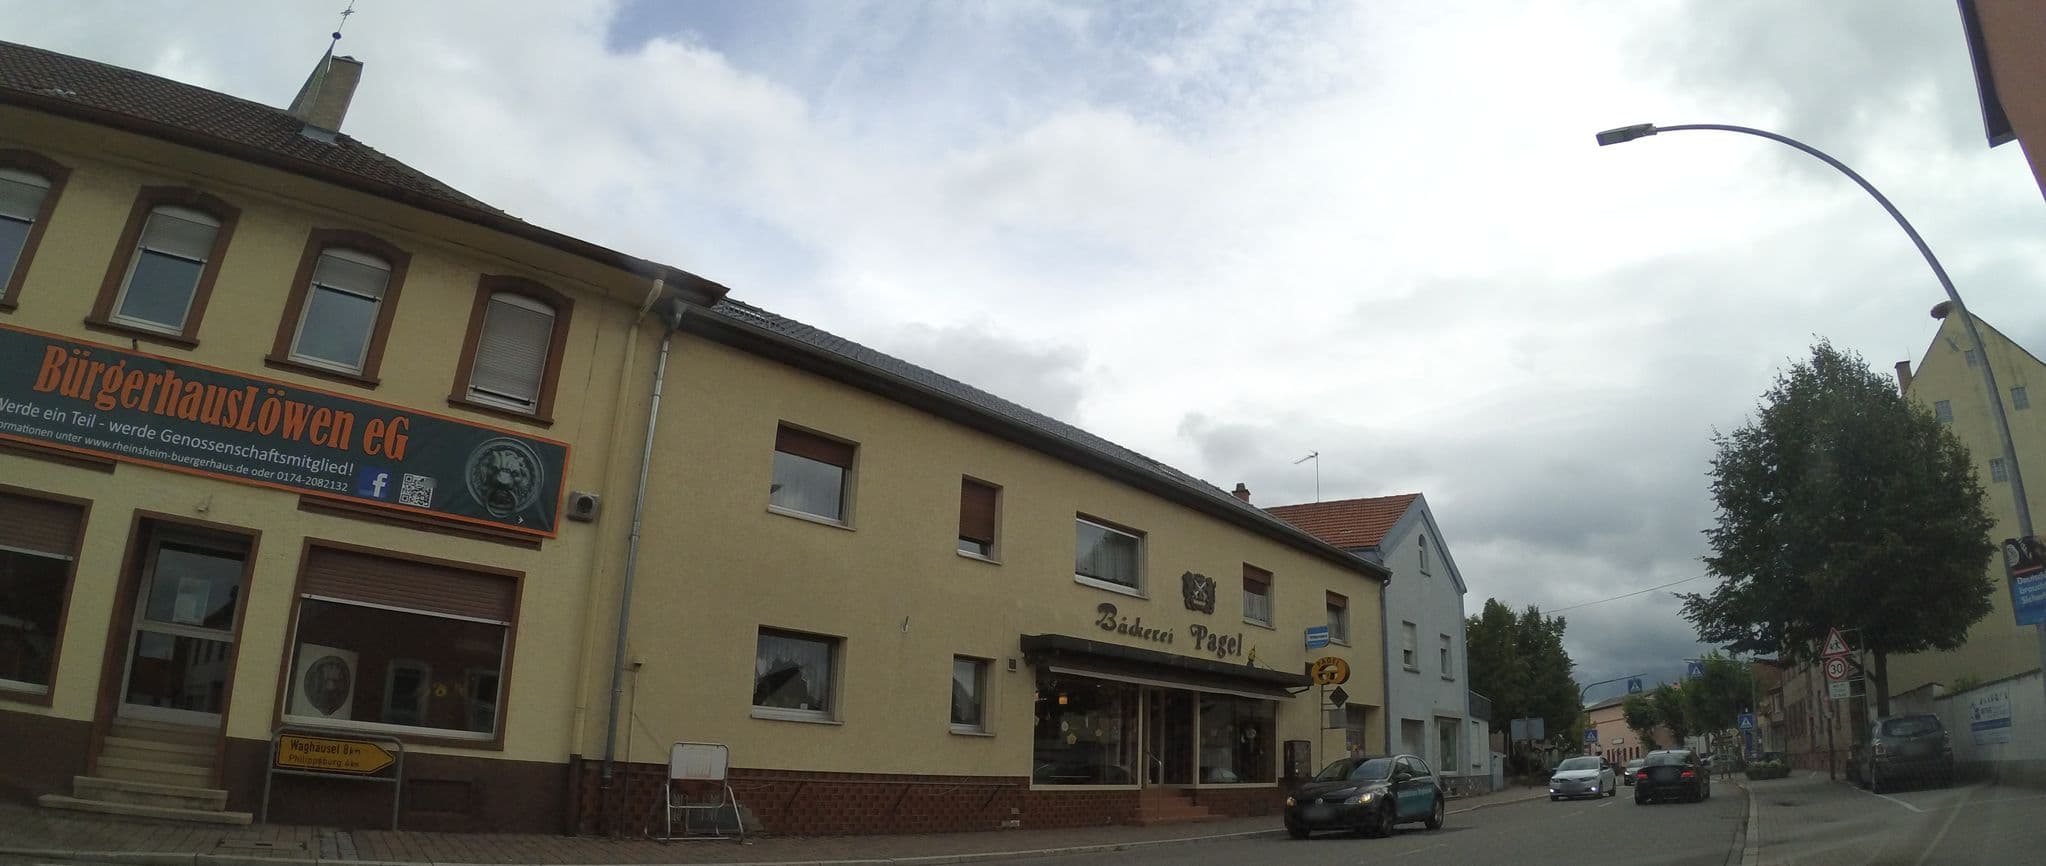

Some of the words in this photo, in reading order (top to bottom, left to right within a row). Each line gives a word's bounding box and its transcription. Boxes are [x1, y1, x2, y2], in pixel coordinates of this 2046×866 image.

[33, 344, 355, 450] BürgerhausLöwen
[363, 416, 409, 461] eG
[0, 421, 53, 439] ormationen
[56, 431, 82, 444] unter
[84, 437, 249, 475] www.rheinsheim-buergerhaus.de
[251, 468, 276, 480] oder
[277, 471, 349, 492] 0174-2082132
[43, 407, 66, 423] ein
[72, 410, 97, 428] Teil
[109, 420, 156, 440] werde
[160, 429, 354, 476] Genossenschaftsmitglied!
[1095, 602, 1174, 644] Bäckerei
[1190, 623, 1243, 659] Pagel
[1830, 663, 1843, 674] 30
